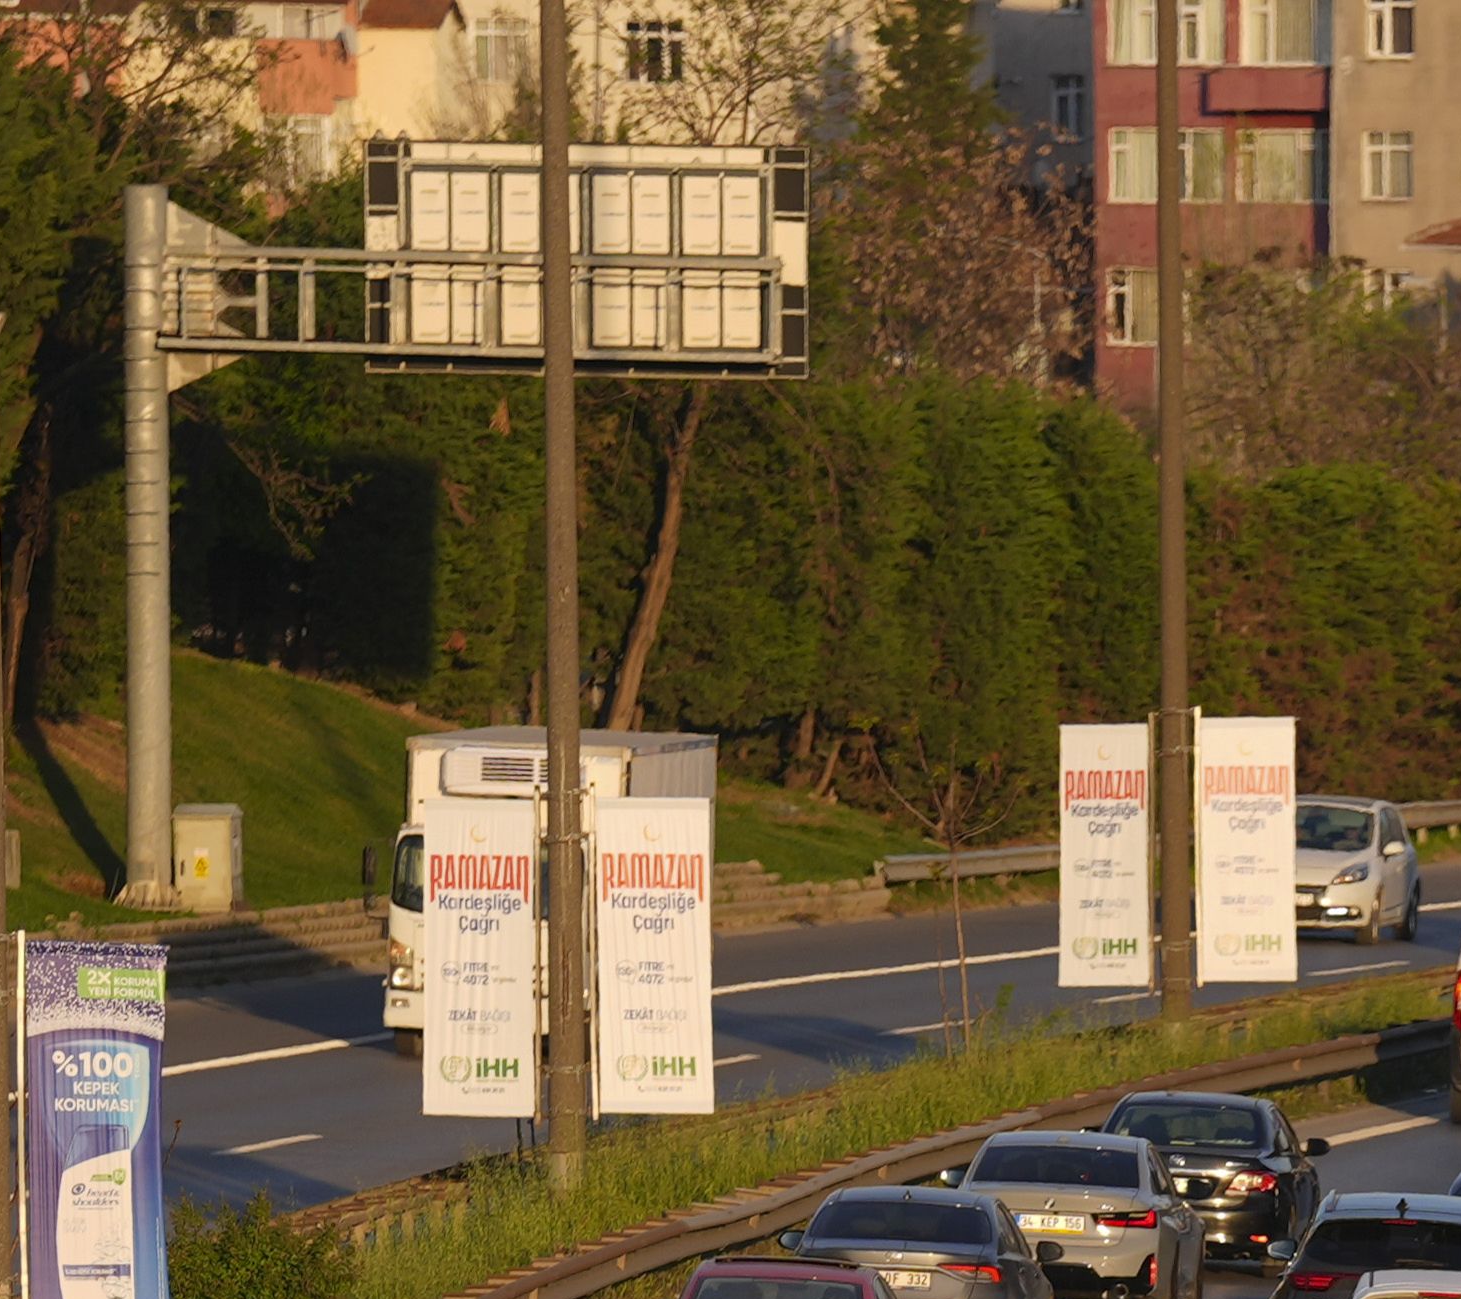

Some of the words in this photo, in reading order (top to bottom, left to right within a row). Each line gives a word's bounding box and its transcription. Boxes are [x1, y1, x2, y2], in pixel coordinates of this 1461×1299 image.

[1065, 770, 1146, 811] RAMAZAN
[1204, 765, 1290, 806] RAMAZAN
[430, 854, 529, 903] RAMAZAN
[602, 853, 704, 903] RAMAZAN
[438, 893, 522, 914] Kardeşliğe
[611, 892, 696, 914] Kardeşliğe
[459, 915, 499, 935] Çağrı
[633, 914, 675, 934] Çağrı
[88, 970, 112, 985] 2X
[114, 976, 157, 987] KORUMA
[89, 986, 111, 996] YENİ
[114, 986, 155, 998] FORMÜL
[52, 1050, 134, 1078] %100
[73, 1081, 120, 1095] KEPEK
[54, 1098, 134, 1112] KORUMASI
[1020, 1216, 1032, 1226] 34
[1041, 1217, 1059, 1228] KEP
[1065, 1218, 1081, 1229] 156
[907, 1274, 928, 1286] 332
